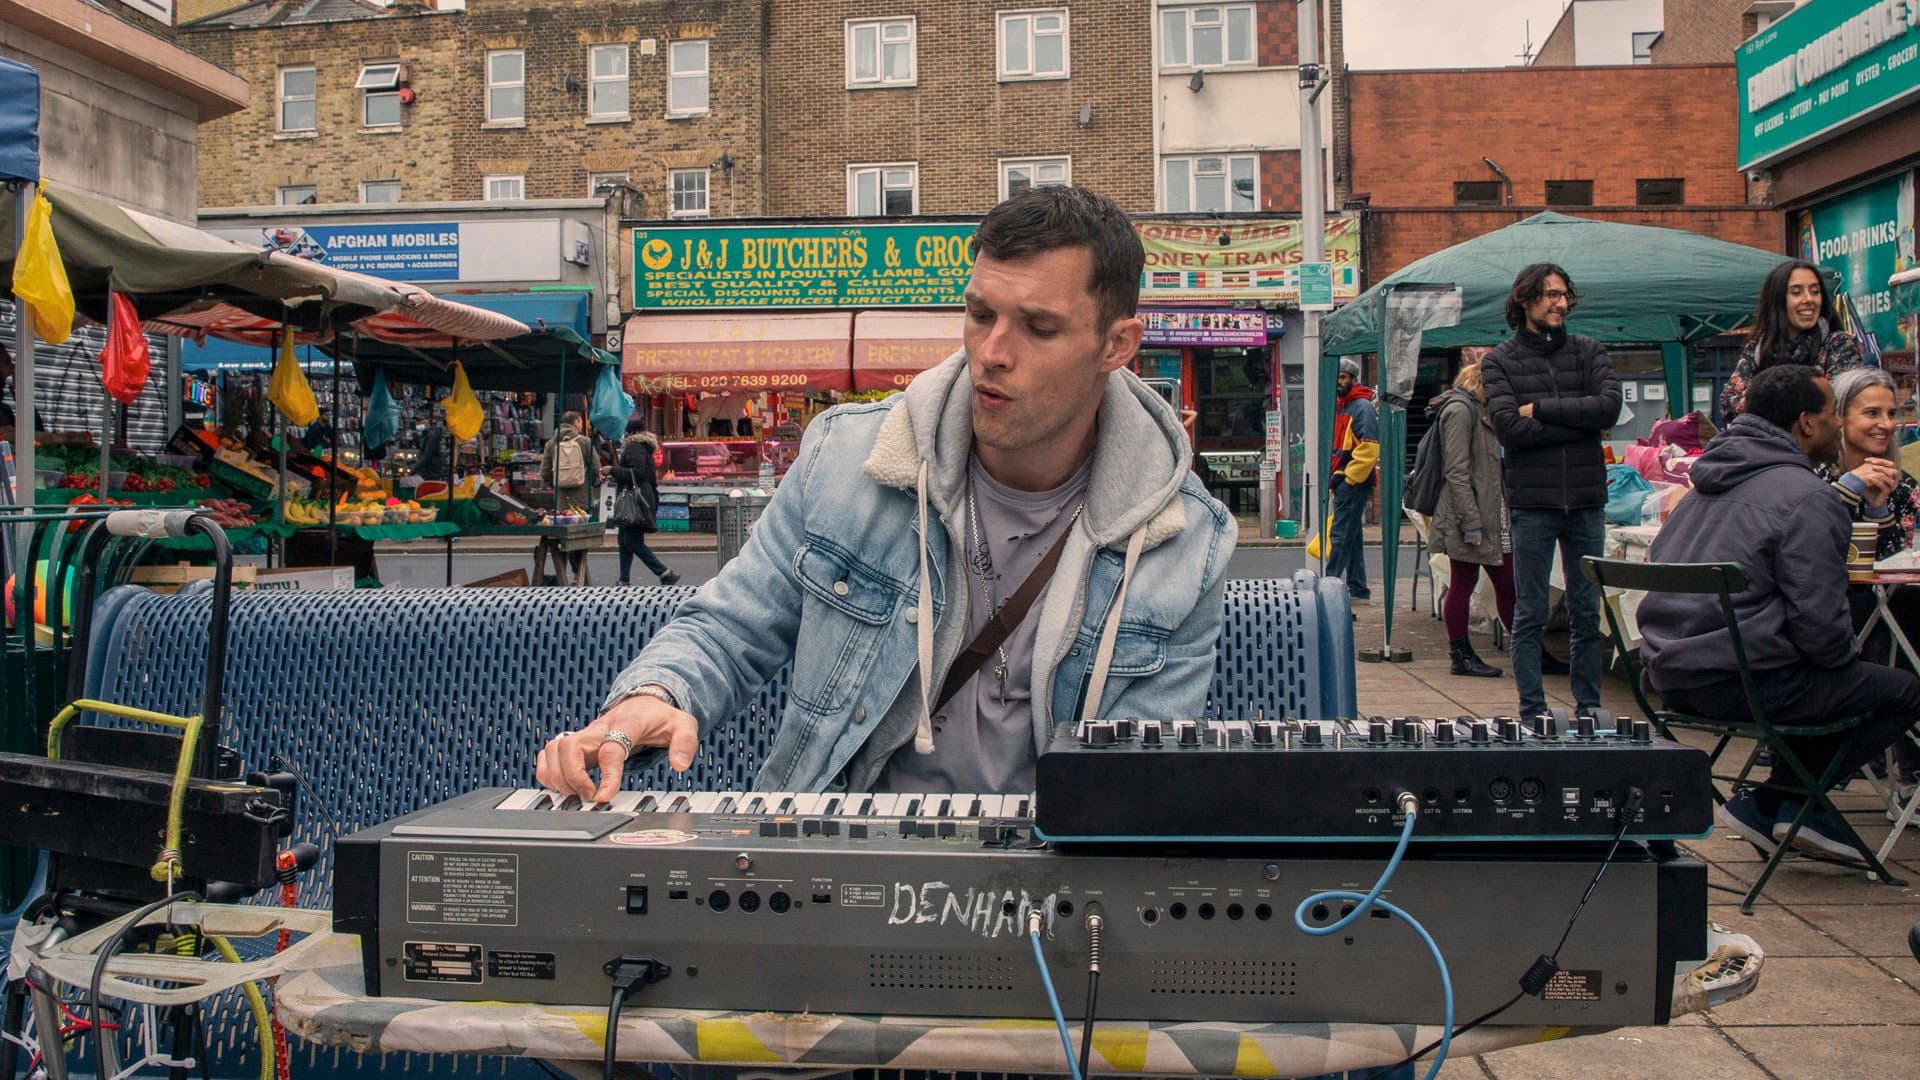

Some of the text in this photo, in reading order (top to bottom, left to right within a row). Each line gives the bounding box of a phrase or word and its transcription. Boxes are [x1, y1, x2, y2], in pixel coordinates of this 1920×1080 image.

[1790, 98, 1812, 120] LOTTERY
[1831, 79, 1848, 100] POINT
[1856, 63, 1880, 87] OYSTER
[1888, 43, 1918, 71] GROCERY
[327, 232, 458, 249] AFGHAN MOBILES
[383, 253, 422, 261] UNLOCKING
[742, 237, 868, 269] BUTCHERS
[884, 236, 900, 268] &
[1144, 248, 1350, 267] ONEY TRANSER
[644, 271, 752, 280] SPECIALISTS
[756, 270, 775, 279] IN
[780, 269, 866, 279] POULTRY,
[873, 268, 930, 278] LAMB,
[1853, 264, 1861, 283] &
[649, 278, 968, 289] BEST QUALITY & CHEAPEST
[715, 289, 801, 297] DISCOUNTS
[808, 288, 838, 296] FOR
[847, 287, 955, 295] RESTAURANTS
[661, 298, 769, 306] WHOLESALE
[771, 297, 833, 305] PRICES
[838, 295, 901, 304] DIRECT
[910, 295, 933, 303] TO
[1854, 290, 1891, 316] ERIES
[635, 349, 692, 366] FRESH
[701, 376, 728, 387] 020
[771, 374, 807, 386] 9200
[1624, 388, 1632, 400] E
[411, 853, 434, 861] CAUTION
[411, 875, 440, 883] ATTENTION
[411, 903, 437, 911] WARNING
[888, 881, 1056, 941] DENHAM
